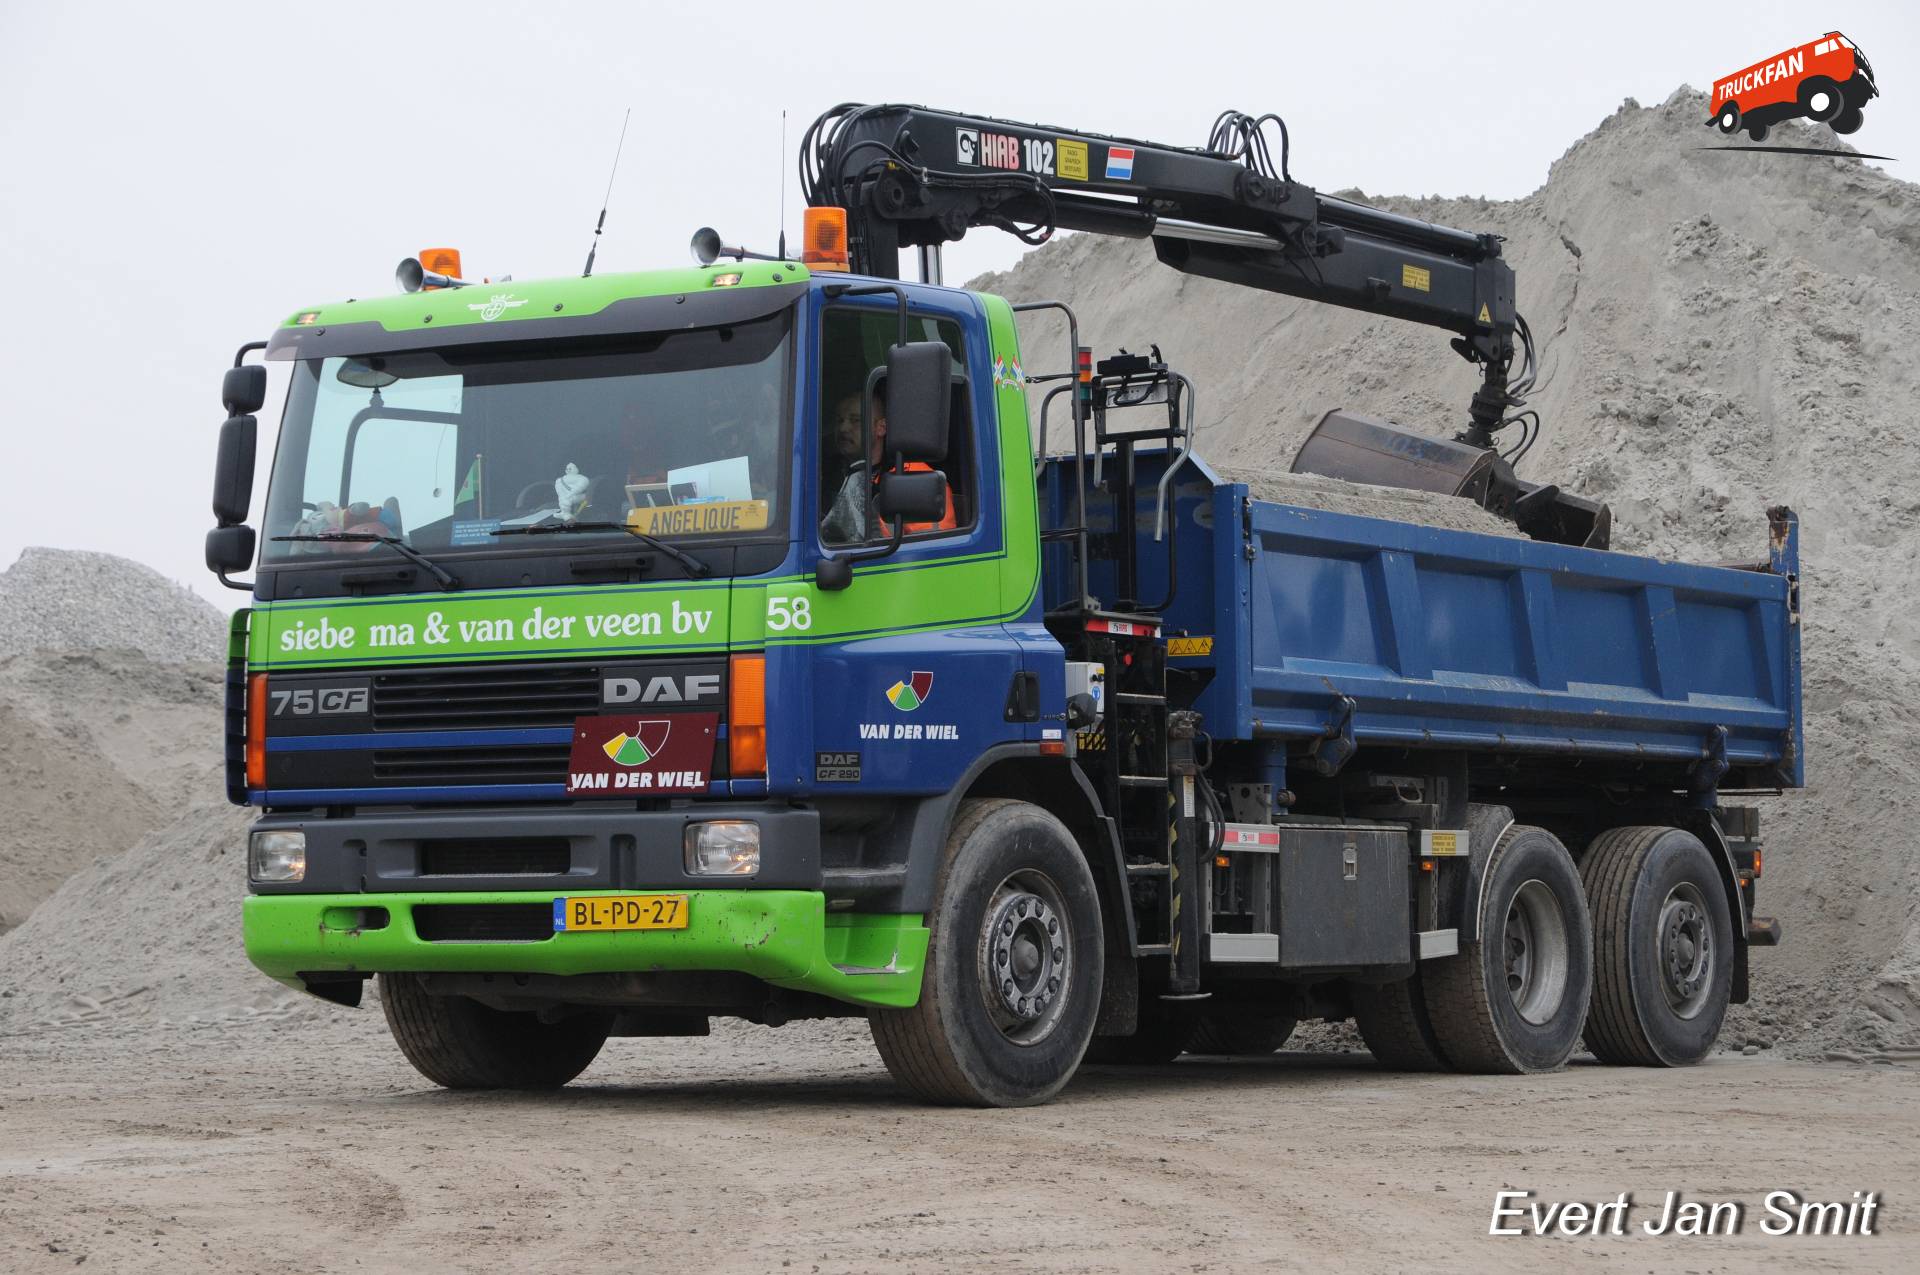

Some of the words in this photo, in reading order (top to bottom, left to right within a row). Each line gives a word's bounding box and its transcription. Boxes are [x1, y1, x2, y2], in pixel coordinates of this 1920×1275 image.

[981, 132, 1020, 170] HIAB
[1023, 138, 1054, 175] 102
[648, 506, 742, 535] ANGELIQUE
[280, 616, 355, 651] siebe
[369, 622, 415, 647] ma
[423, 611, 450, 645] &
[458, 618, 514, 643] van
[521, 606, 577, 640] der
[584, 611, 662, 638] veen
[671, 600, 713, 634] bv
[766, 596, 812, 631] 58
[603, 674, 720, 704] DAF
[859, 724, 890, 740] VAN
[893, 724, 922, 740] DER
[925, 725, 959, 740] WIEL
[820, 754, 858, 765] DAF
[570, 773, 609, 789] VAN
[614, 772, 653, 788] DER
[657, 771, 705, 787] WIEL
[818, 768, 838, 779] CF
[838, 768, 860, 779] 290
[555, 918, 565, 926] NL
[575, 900, 679, 926] BL-PD-27
